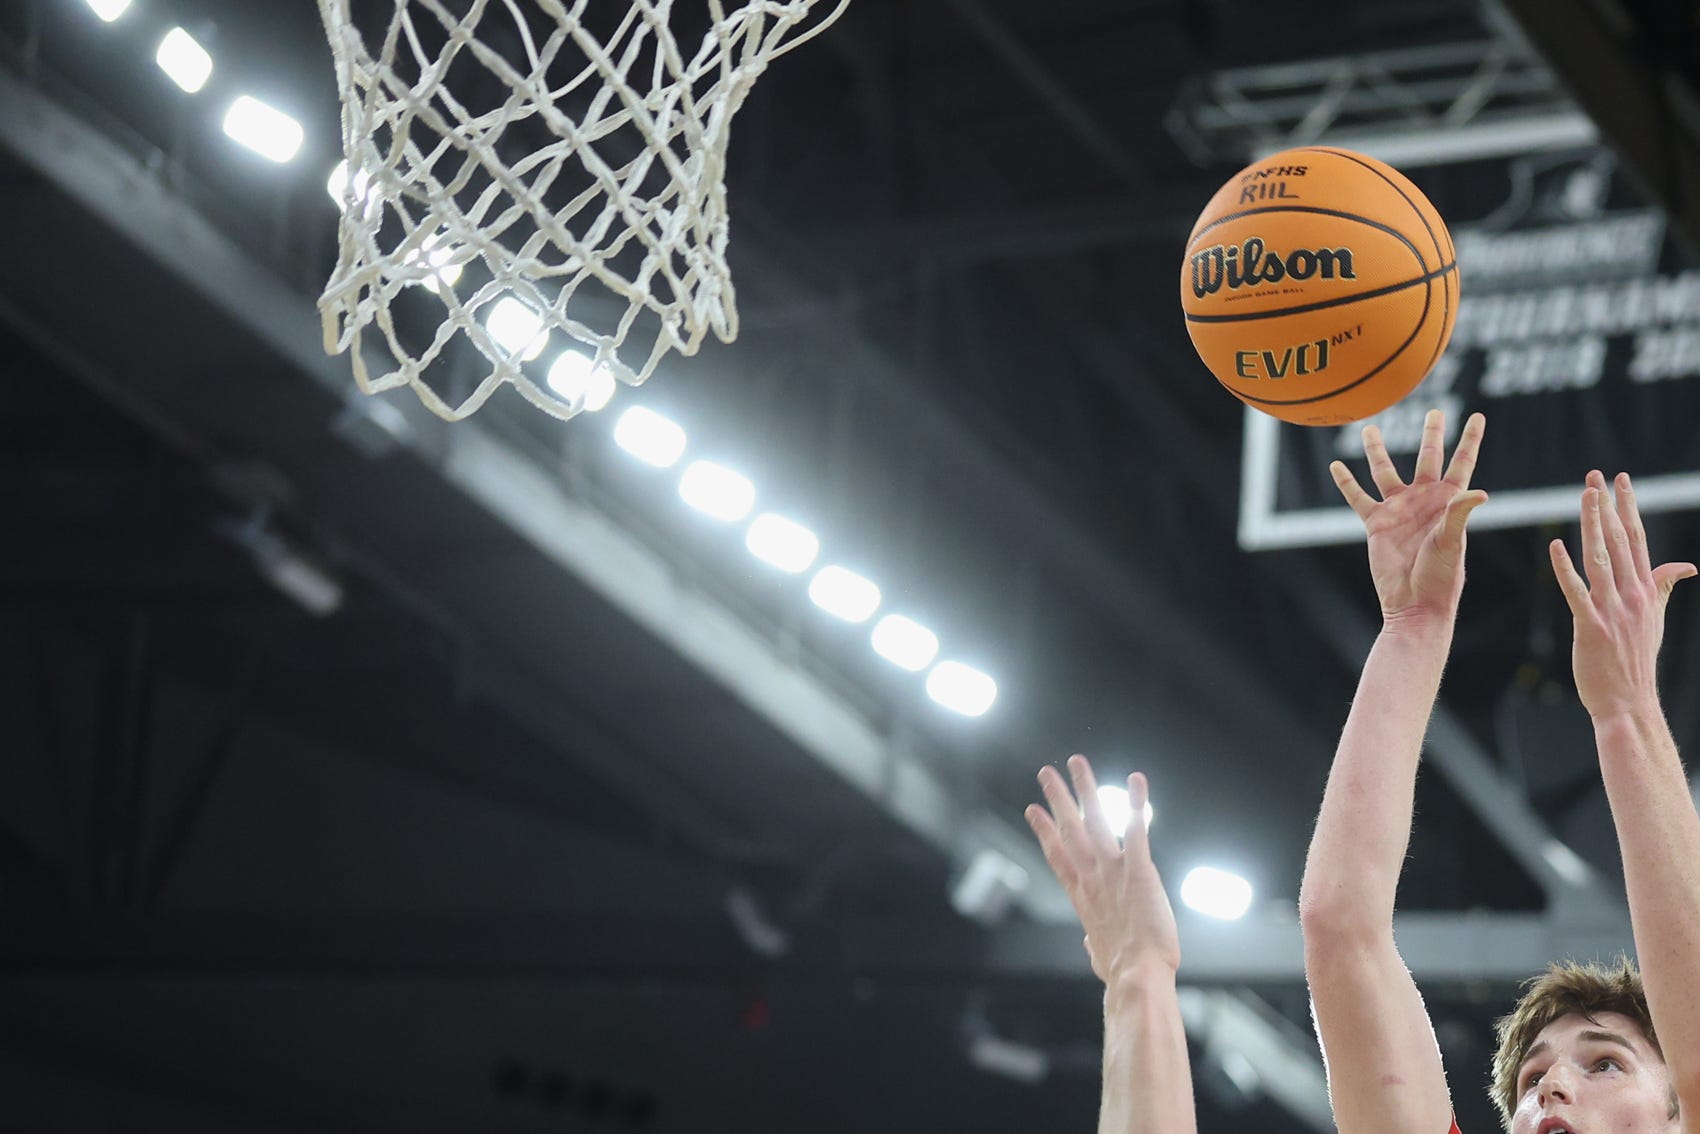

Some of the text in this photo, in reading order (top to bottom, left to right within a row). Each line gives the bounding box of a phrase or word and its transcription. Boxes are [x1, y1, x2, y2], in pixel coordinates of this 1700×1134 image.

[1191, 237, 1356, 298] Wilson
[1235, 323, 1363, 380] EVO NXT
